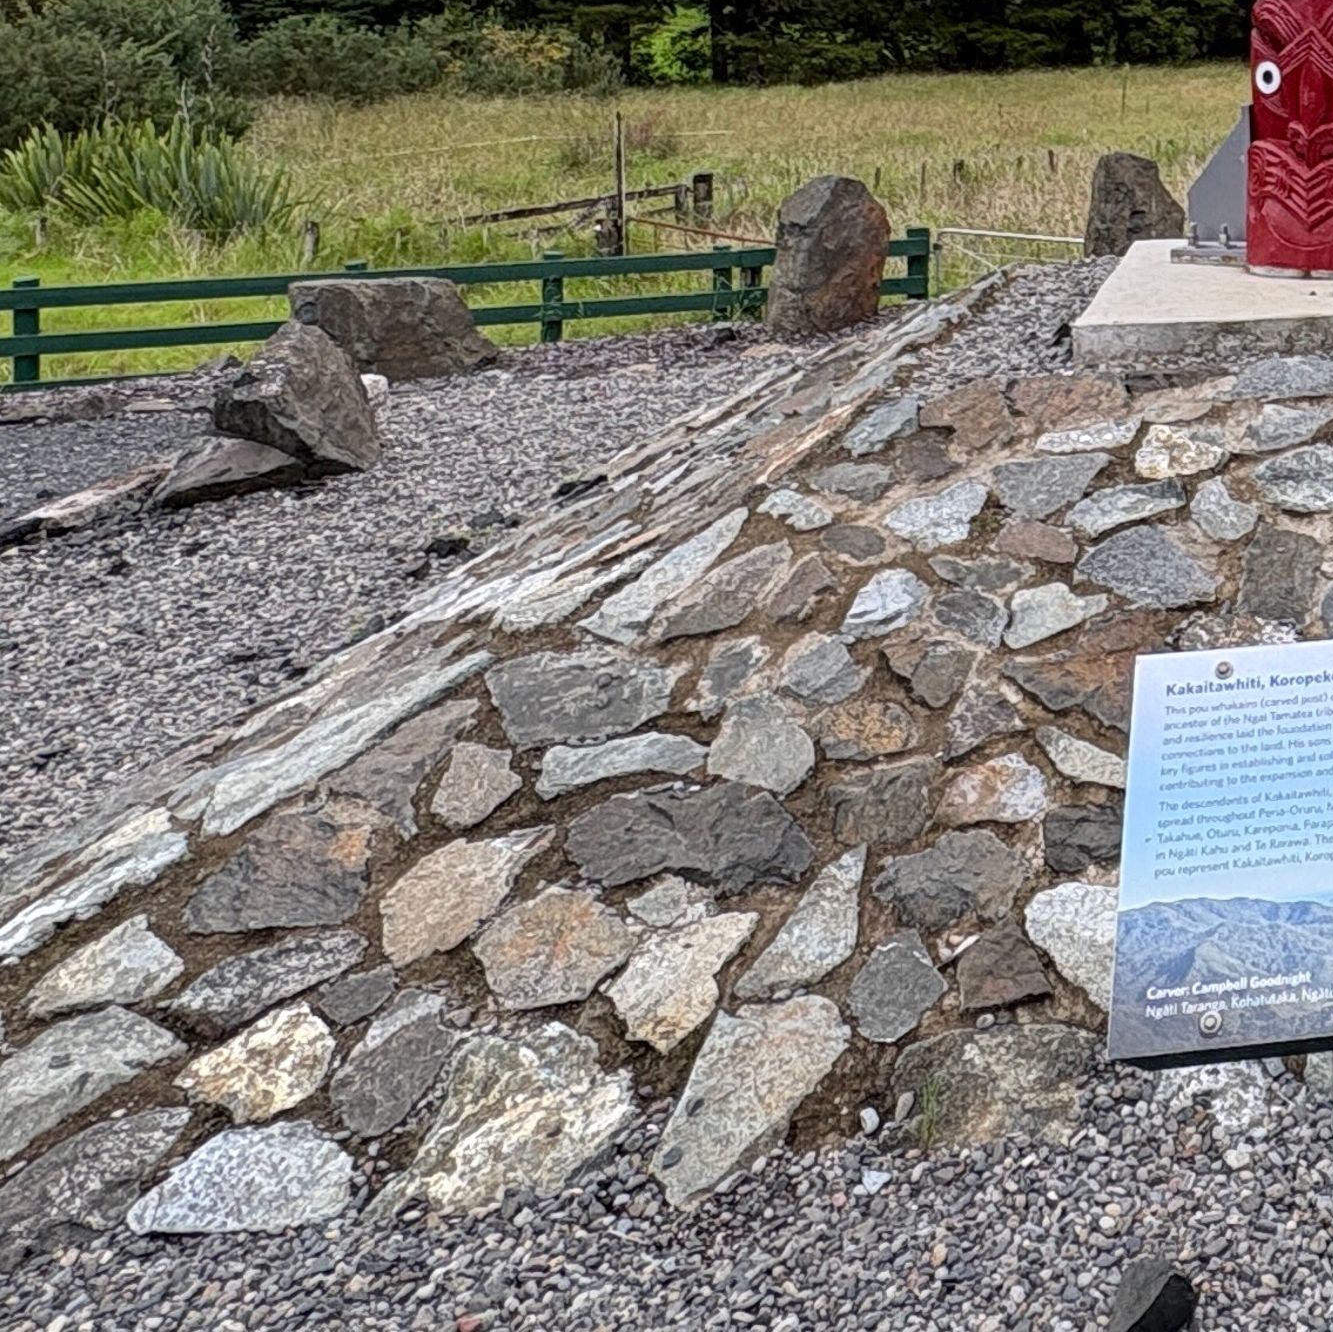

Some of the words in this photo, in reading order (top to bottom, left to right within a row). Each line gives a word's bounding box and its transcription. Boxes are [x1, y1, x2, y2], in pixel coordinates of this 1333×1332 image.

[1166, 676, 1265, 696] Kakaitawhiti,
[1165, 705, 1186, 715] This
[1189, 705, 1208, 716] pou
[1211, 716, 1221, 726] of
[1224, 715, 1240, 725] the
[1163, 734, 1182, 745] and
[1236, 728, 1255, 738] laid
[1258, 727, 1274, 736] the
[1228, 745, 1238, 754] to
[1241, 743, 1258, 753] the
[1288, 739, 1305, 748] His
[1308, 738, 1331, 747] sons
[1161, 765, 1178, 776] key
[1220, 760, 1229, 770] in
[1297, 752, 1316, 763] and
[1227, 775, 1237, 784] to
[1240, 773, 1257, 783] the
[1159, 801, 1178, 812] The
[1252, 793, 1262, 803] of
[1155, 850, 1166, 860] in
[1232, 841, 1251, 852] and
[1256, 840, 1266, 850] Te
[1154, 868, 1175, 879] pou
[1146, 986, 1190, 1000] Carver:
[1191, 977, 1247, 995] Campbell
[1249, 970, 1311, 989] Goodnight
